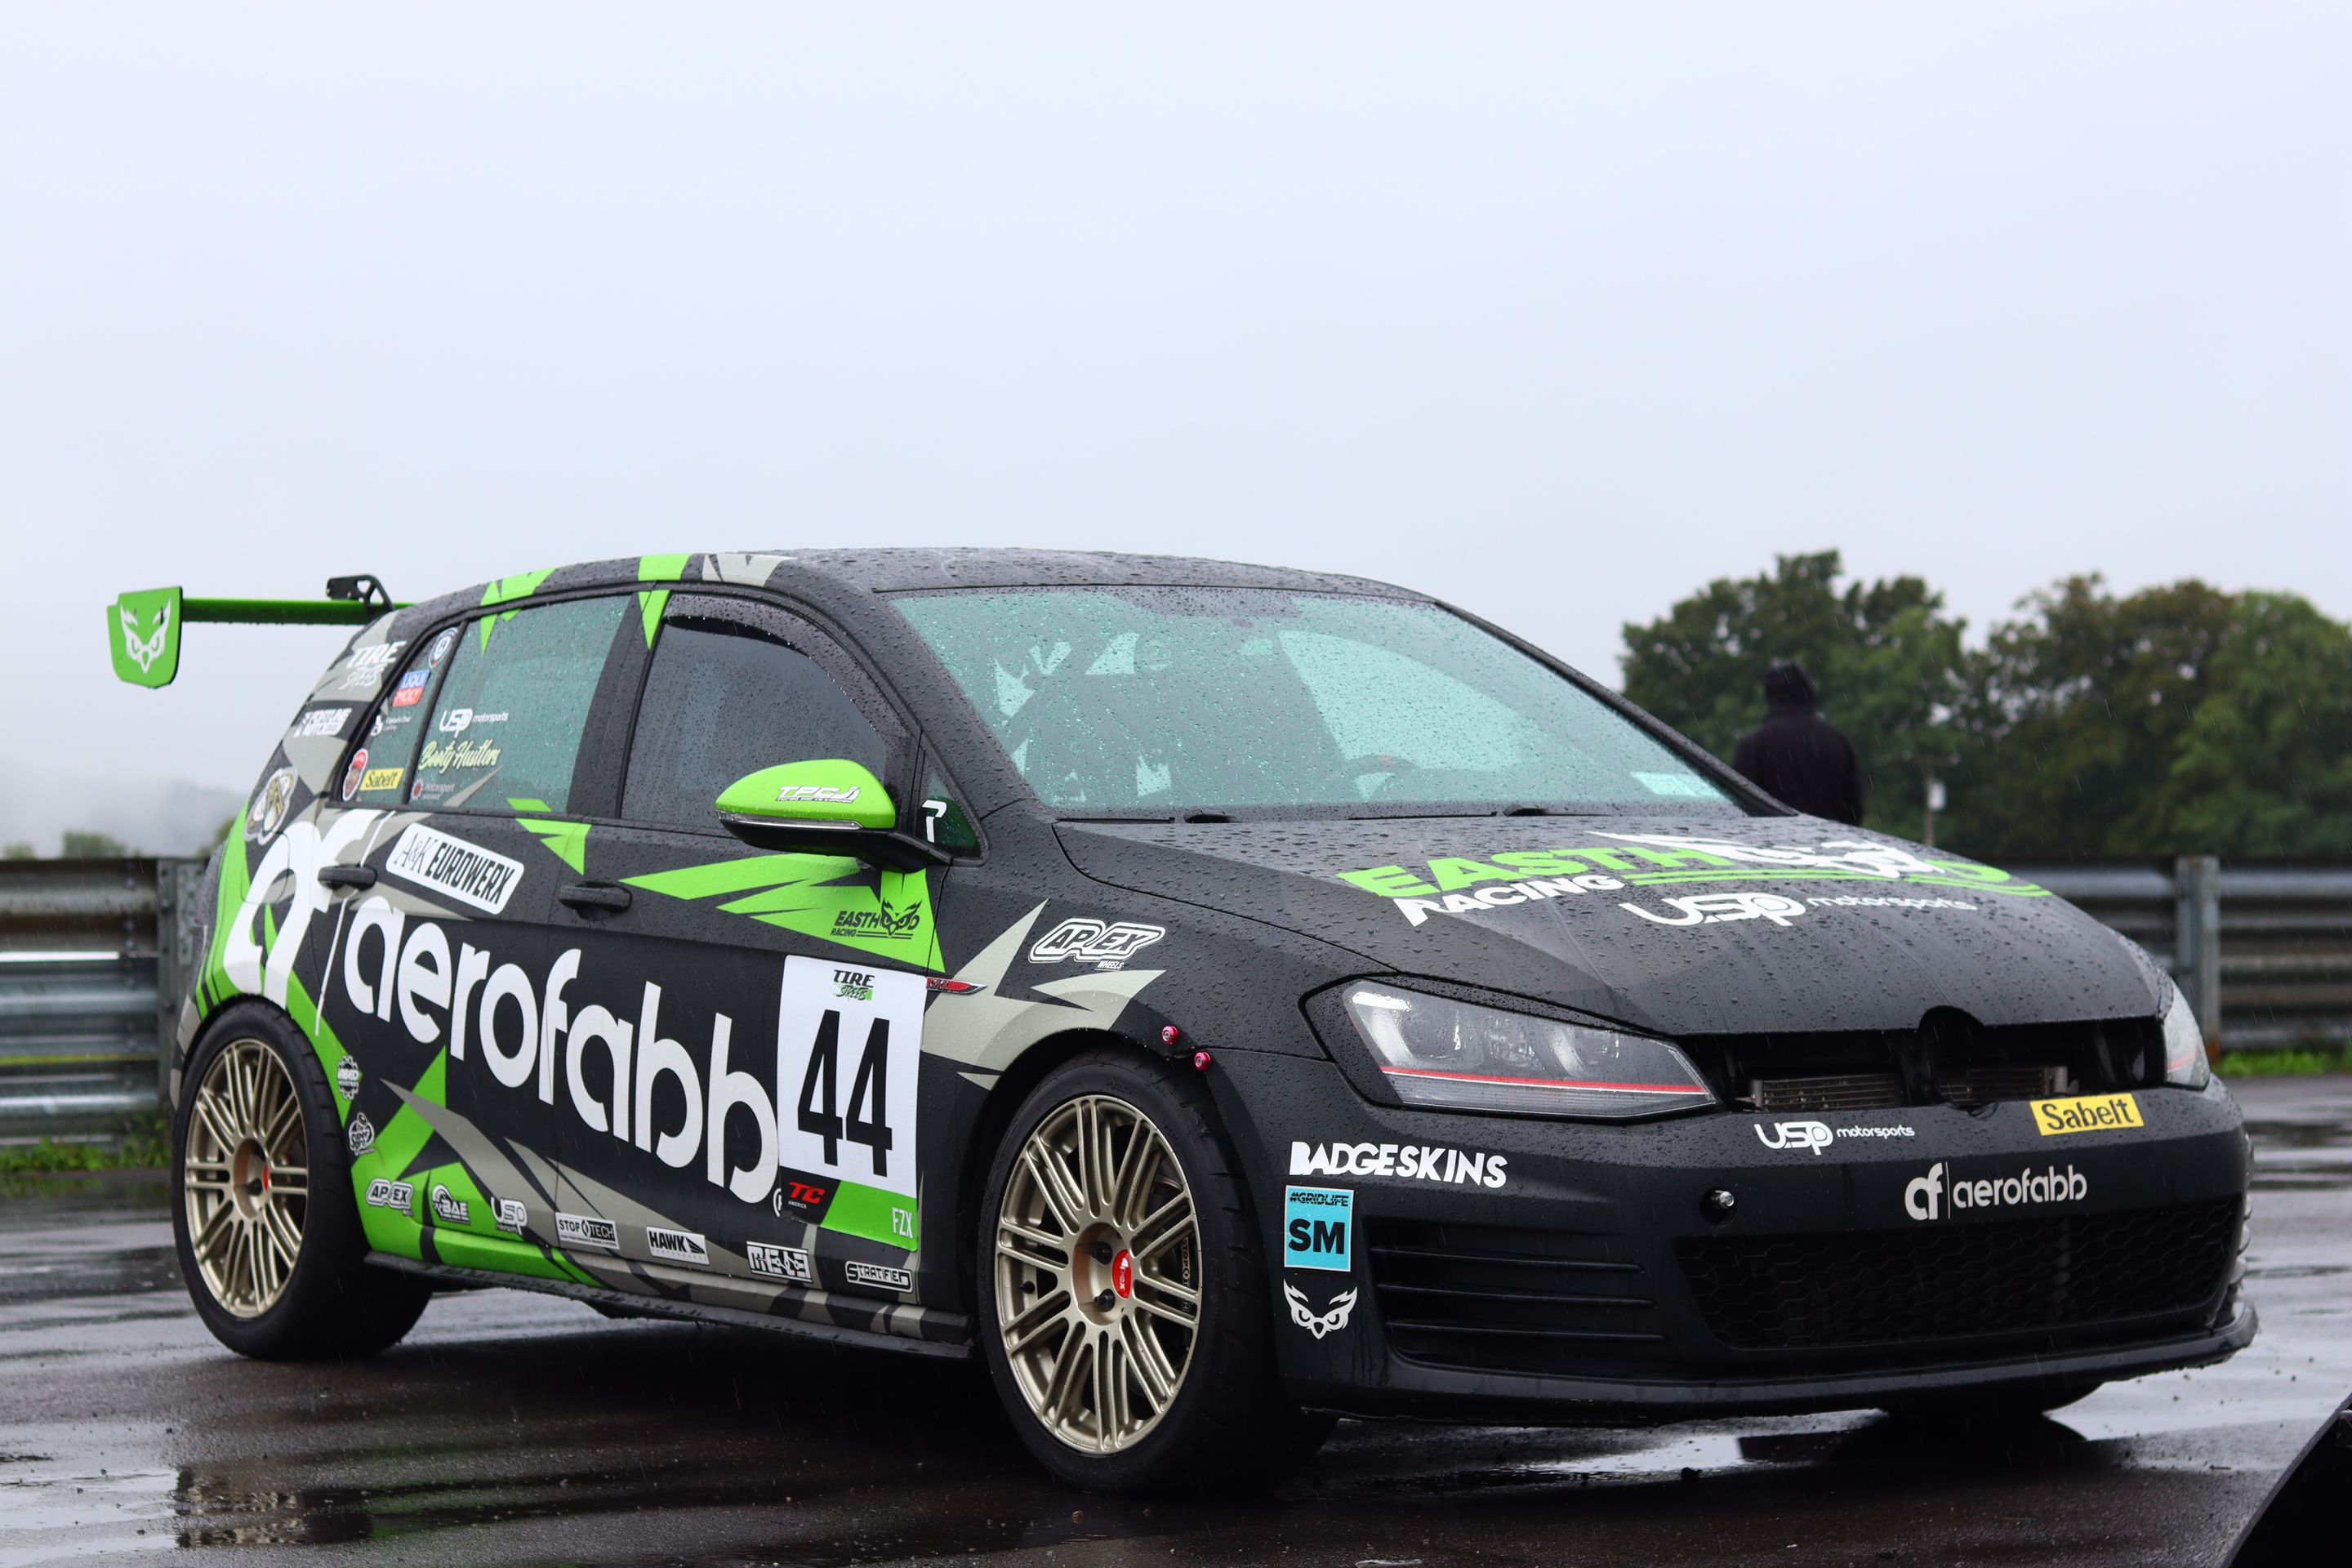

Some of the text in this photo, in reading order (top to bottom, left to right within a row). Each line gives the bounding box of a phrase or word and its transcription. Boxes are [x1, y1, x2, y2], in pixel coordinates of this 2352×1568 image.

[346, 640, 407, 668] TIRE
[366, 770, 399, 789] Sabelt
[394, 832, 515, 905] A&K EUROWERX
[1393, 875, 1625, 927] RACING
[1806, 897, 1978, 911] motorsports
[830, 927, 857, 938] RACING
[1037, 924, 1156, 956] APEX
[834, 969, 875, 988] TIRE
[1097, 960, 1125, 969] WHEELS
[344, 896, 780, 1204] aerofabb
[796, 1009, 893, 1178] 44
[2046, 1097, 2135, 1131] Sabelt
[1754, 1120, 1915, 1156] USP motorsports
[1289, 1141, 1508, 1188] BADGESKINS
[368, 1182, 410, 1205] APEX
[788, 1181, 826, 1205] TC
[1289, 1192, 1349, 1207] #GRIDLIFE
[1953, 1165, 2087, 1208] aerofabb
[788, 1200, 807, 1209] AMERICA
[892, 1207, 913, 1239] FZX
[1288, 1218, 1346, 1254] SM
[648, 1231, 688, 1253] HAWK
[845, 1261, 913, 1293] STRATIFIED
